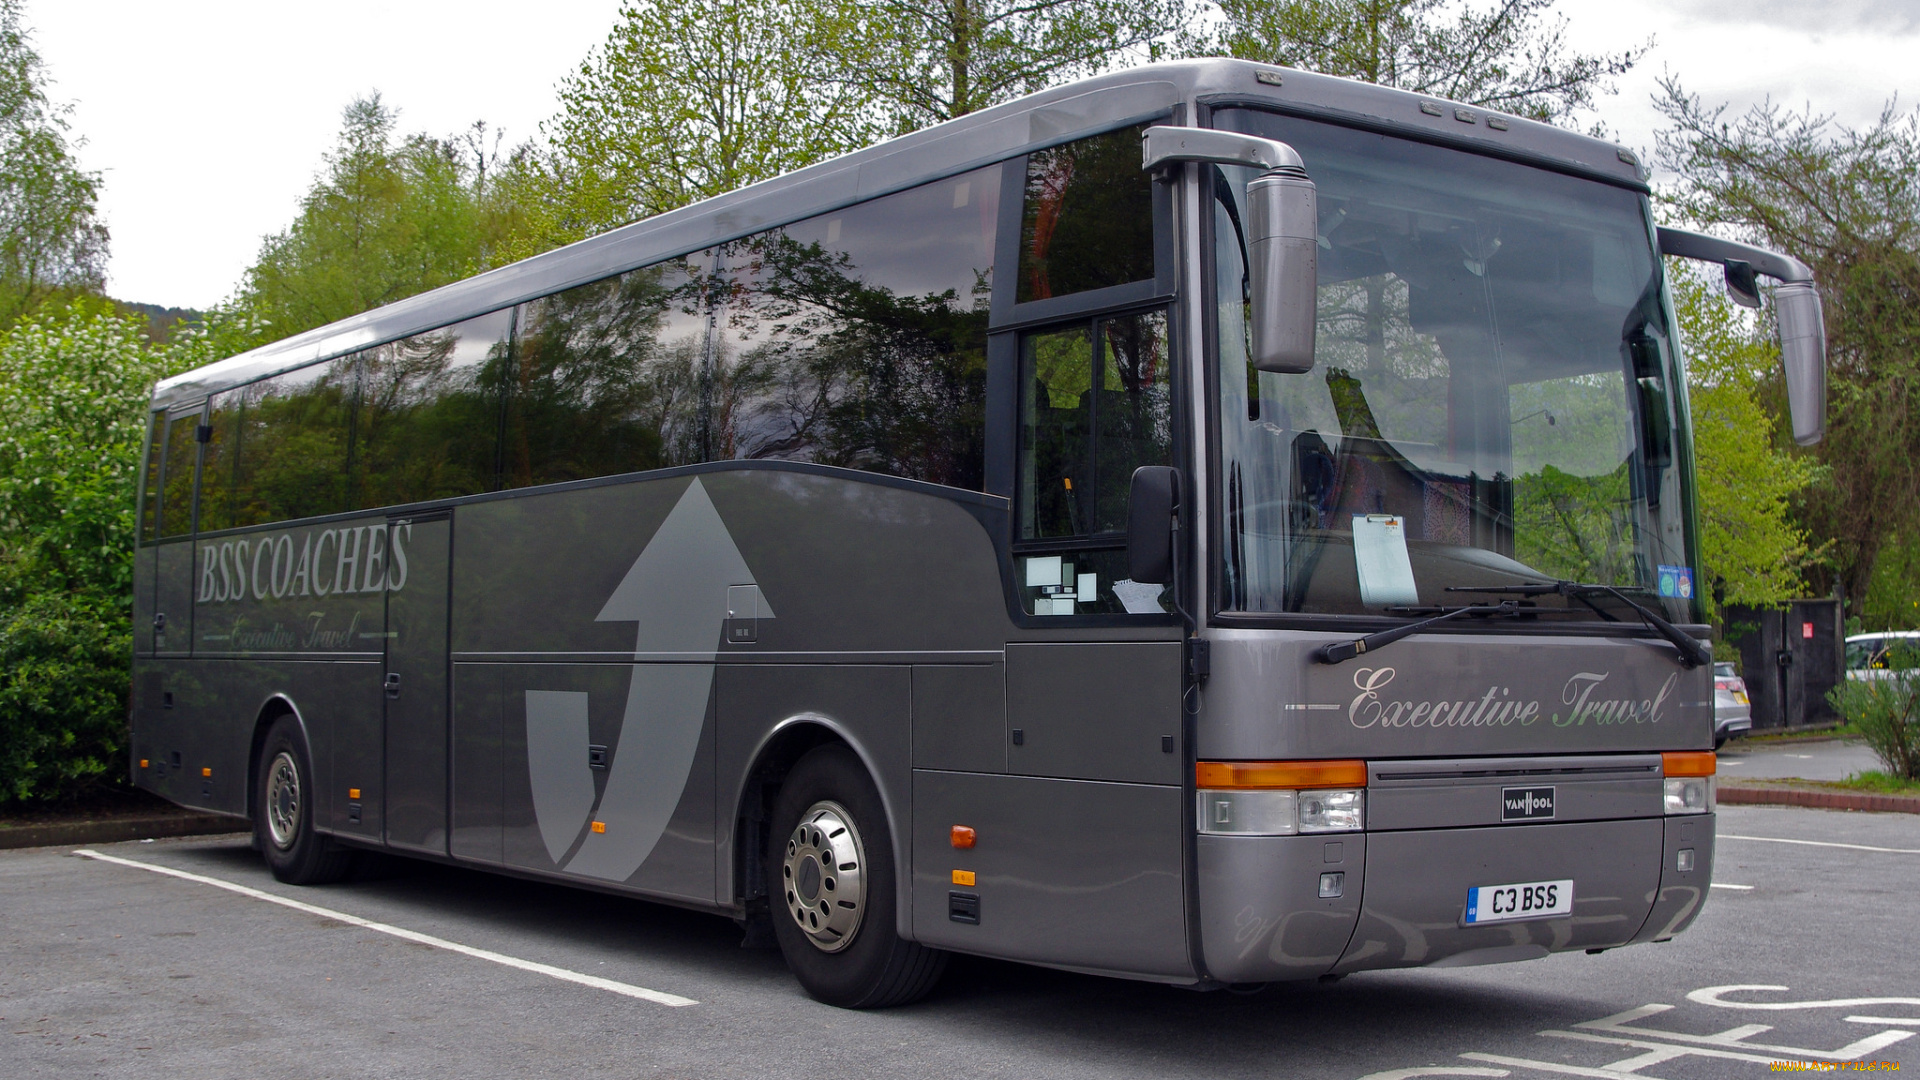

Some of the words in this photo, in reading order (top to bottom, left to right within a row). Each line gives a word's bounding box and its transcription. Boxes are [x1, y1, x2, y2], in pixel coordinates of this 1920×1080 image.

[197, 539, 250, 602] BSS
[252, 519, 412, 599] COACHES
[231, 612, 296, 649] Executive
[302, 610, 361, 648] Travel
[1348, 667, 1540, 729] Executive
[1552, 671, 1678, 728] Travel
[1492, 888, 1518, 914] C3
[1521, 884, 1558, 911] BSS
